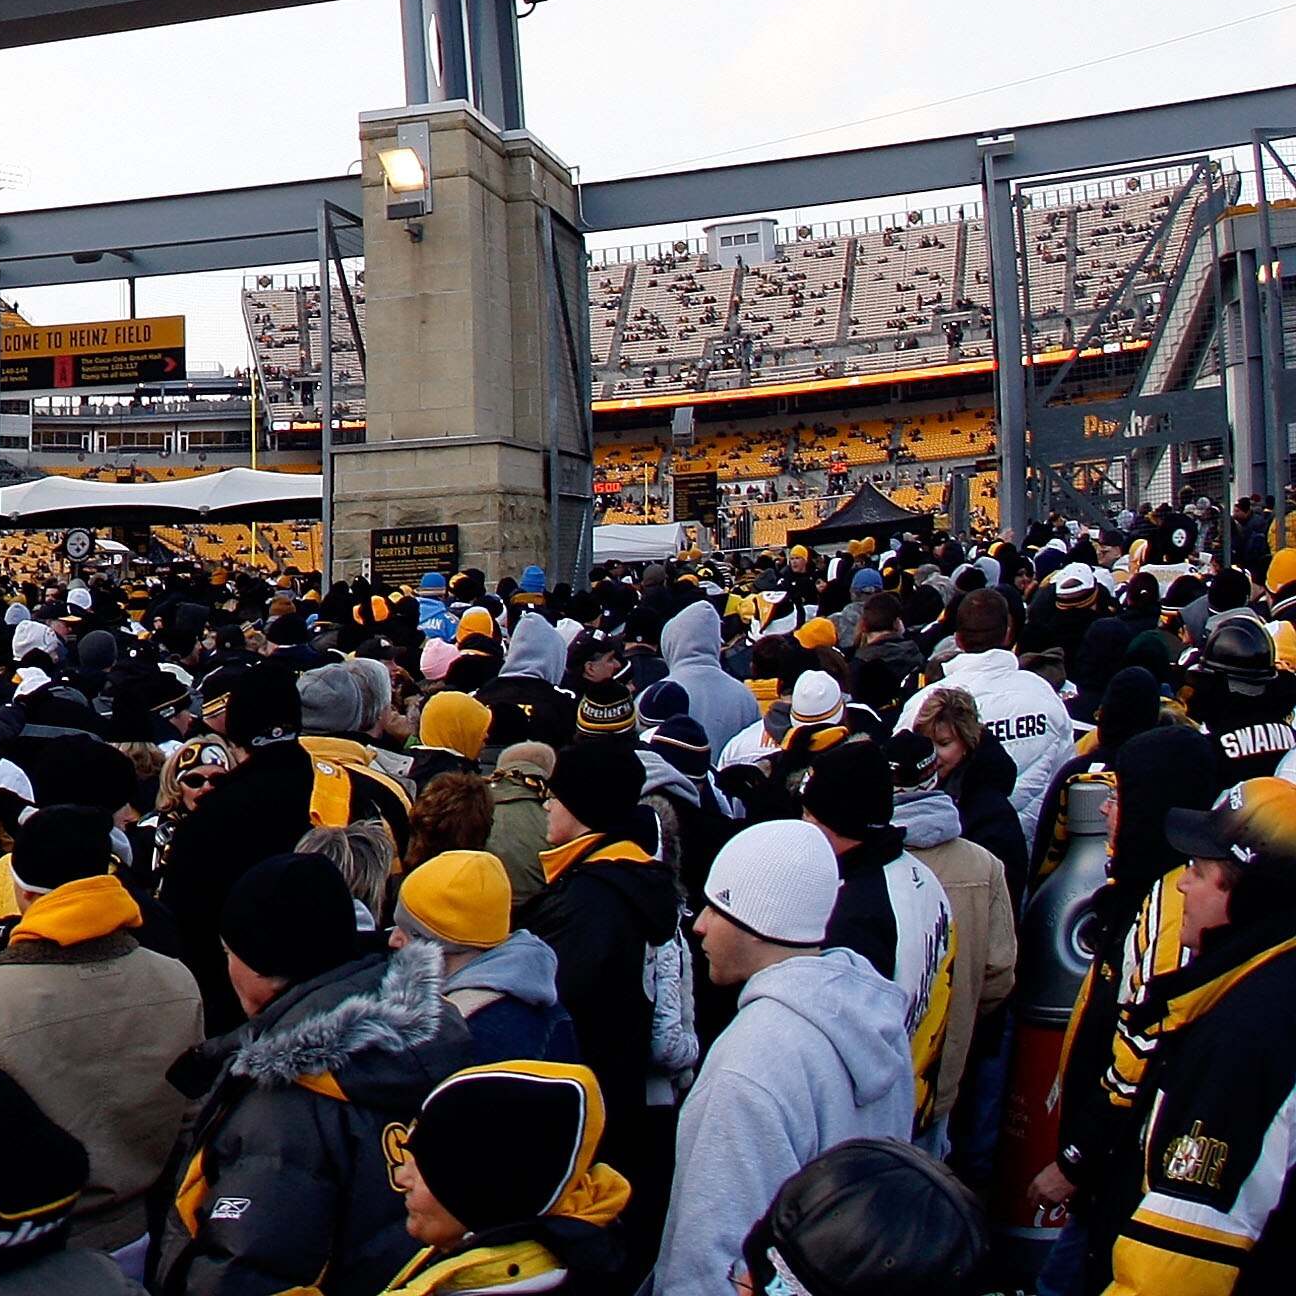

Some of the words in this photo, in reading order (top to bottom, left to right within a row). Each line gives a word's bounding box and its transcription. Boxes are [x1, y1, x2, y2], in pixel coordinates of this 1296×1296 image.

[47, 331, 63, 349] TO
[70, 328, 108, 348] HEINZ
[115, 324, 152, 345] FIELD
[381, 534, 412, 545] HEINZ
[417, 531, 448, 543] FIELD
[1219, 722, 1295, 758] SWANN
